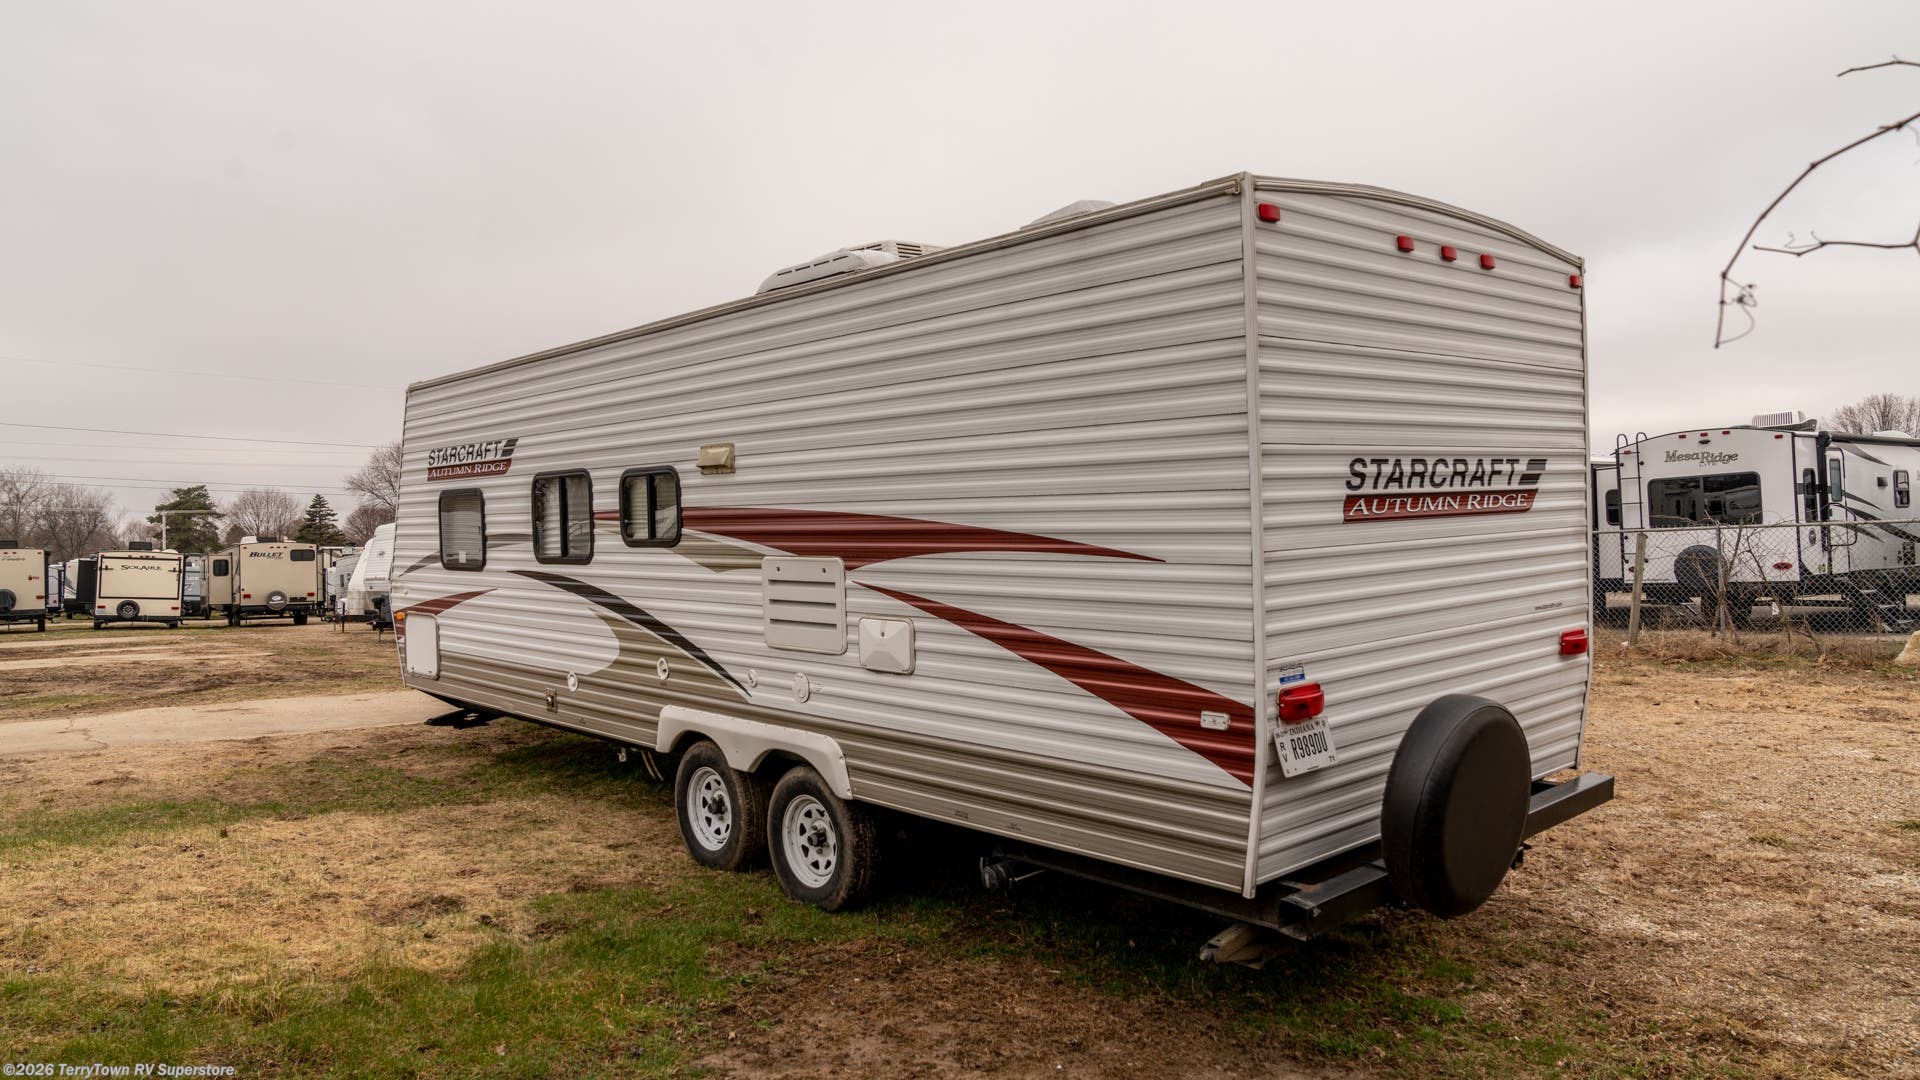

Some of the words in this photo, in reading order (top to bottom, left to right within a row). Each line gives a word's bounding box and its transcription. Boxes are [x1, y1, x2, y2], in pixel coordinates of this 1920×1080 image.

[428, 441, 502, 466] STARCRAFT
[429, 466, 472, 478] AUTUMN
[473, 462, 507, 474] RIDGE
[1345, 457, 1520, 491] STARCRAFT
[1348, 496, 1460, 517] AUTUMN
[1466, 493, 1528, 510] RIDGE
